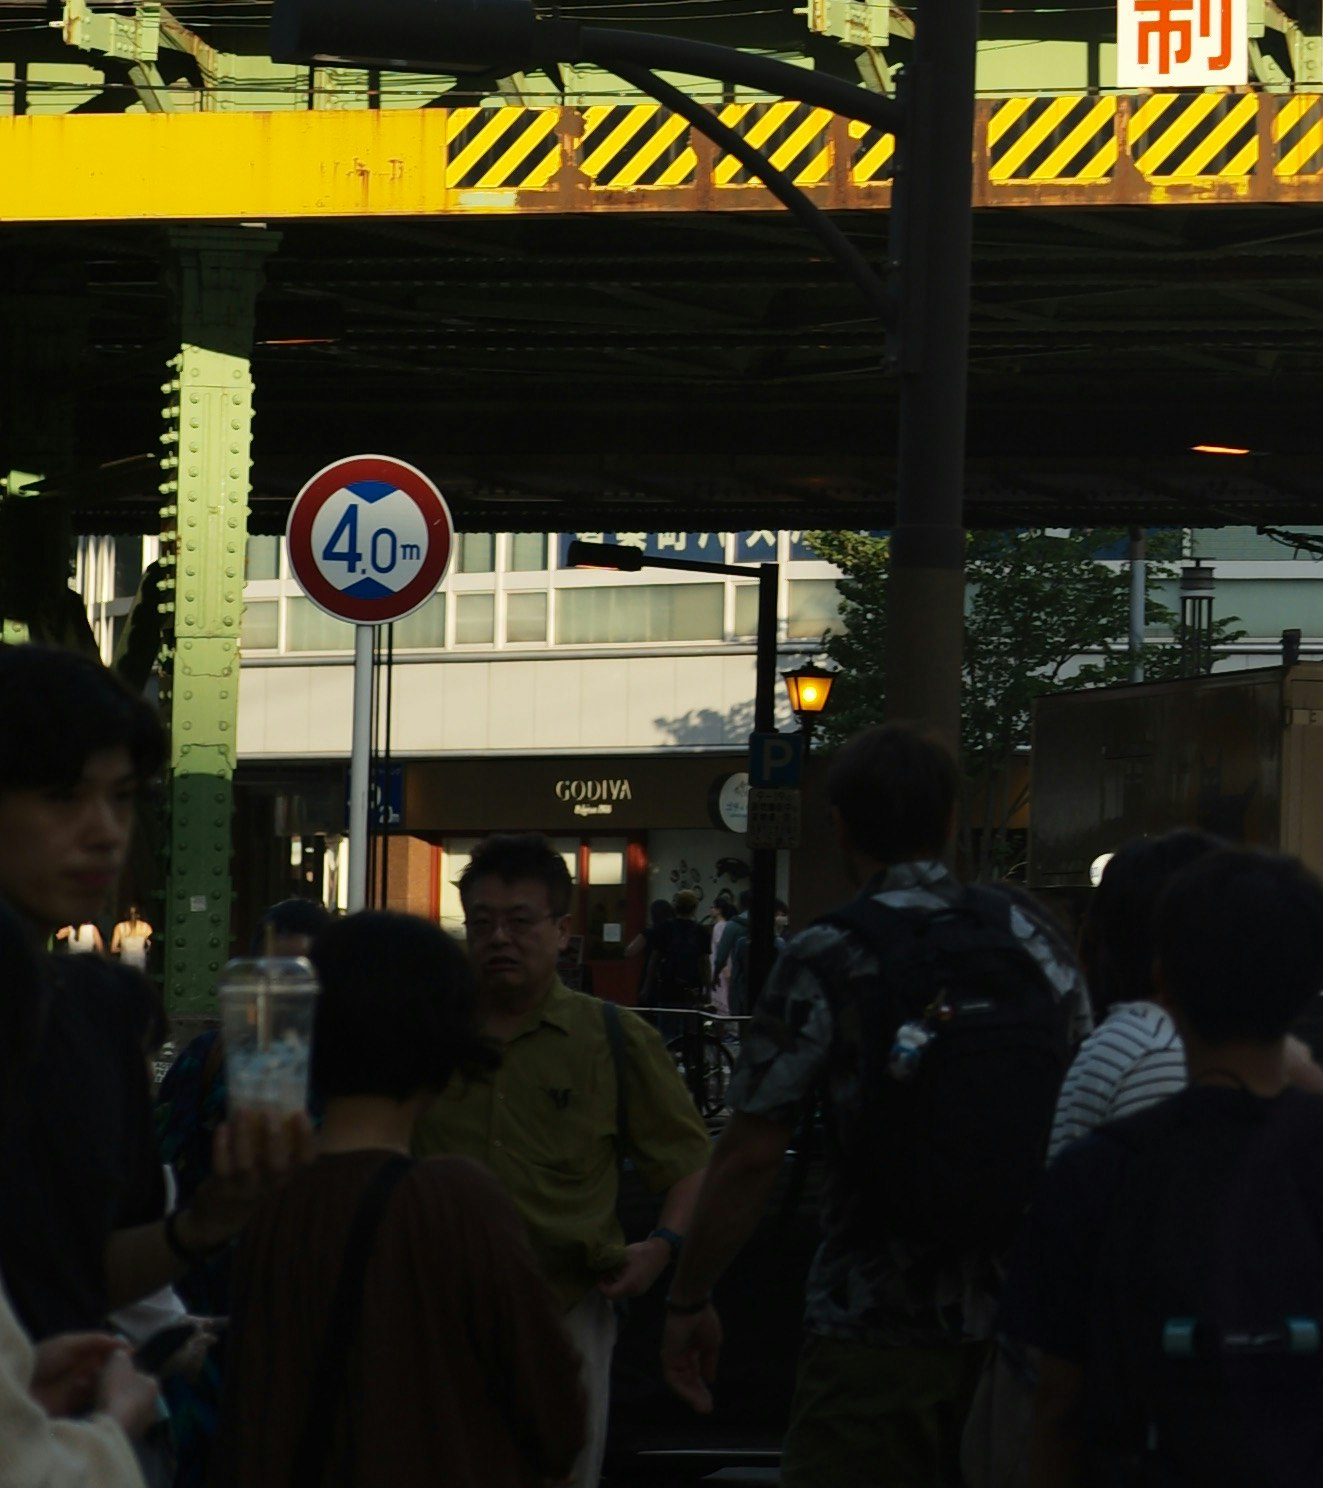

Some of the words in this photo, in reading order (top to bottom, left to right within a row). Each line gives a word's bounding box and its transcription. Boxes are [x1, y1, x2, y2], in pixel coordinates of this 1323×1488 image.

[322, 503, 420, 575] 4.0m
[761, 738, 794, 782] P
[555, 779, 632, 801] GODIVA
